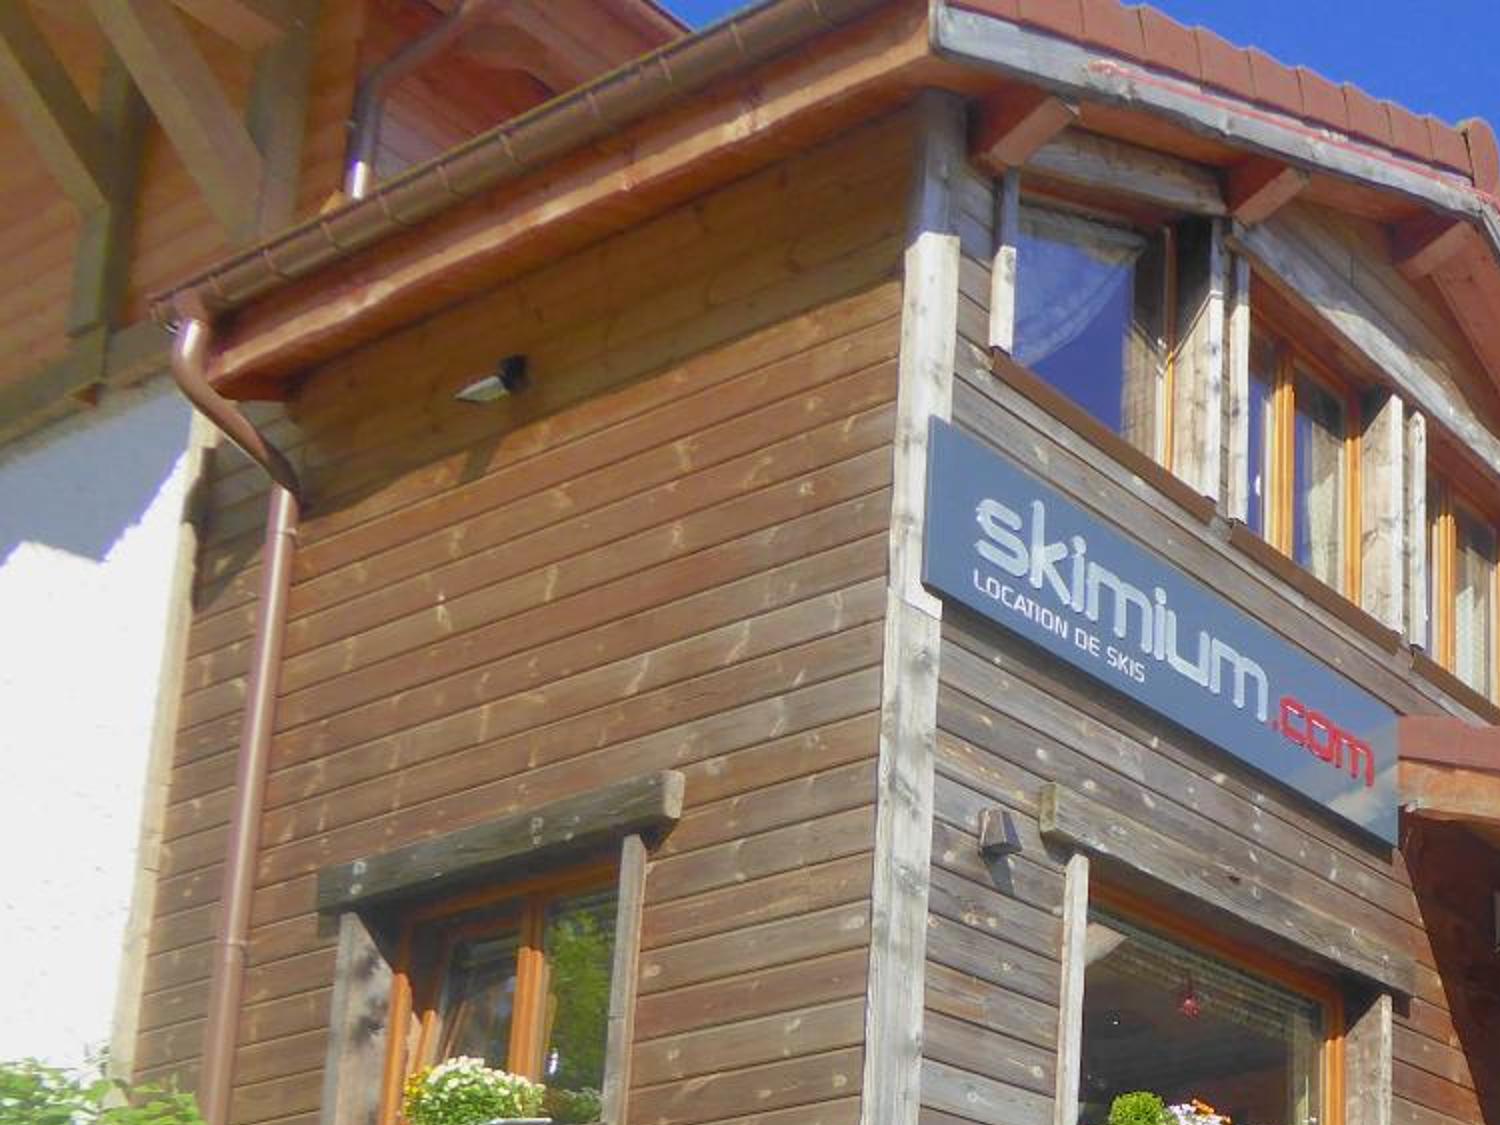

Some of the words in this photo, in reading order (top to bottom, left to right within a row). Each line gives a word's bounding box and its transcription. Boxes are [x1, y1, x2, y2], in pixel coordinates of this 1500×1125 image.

[973, 568, 1068, 639] LOCATION
[1074, 628, 1101, 660] DE
[1107, 645, 1146, 684] SKIS
[974, 498, 1375, 788] skimium.com
